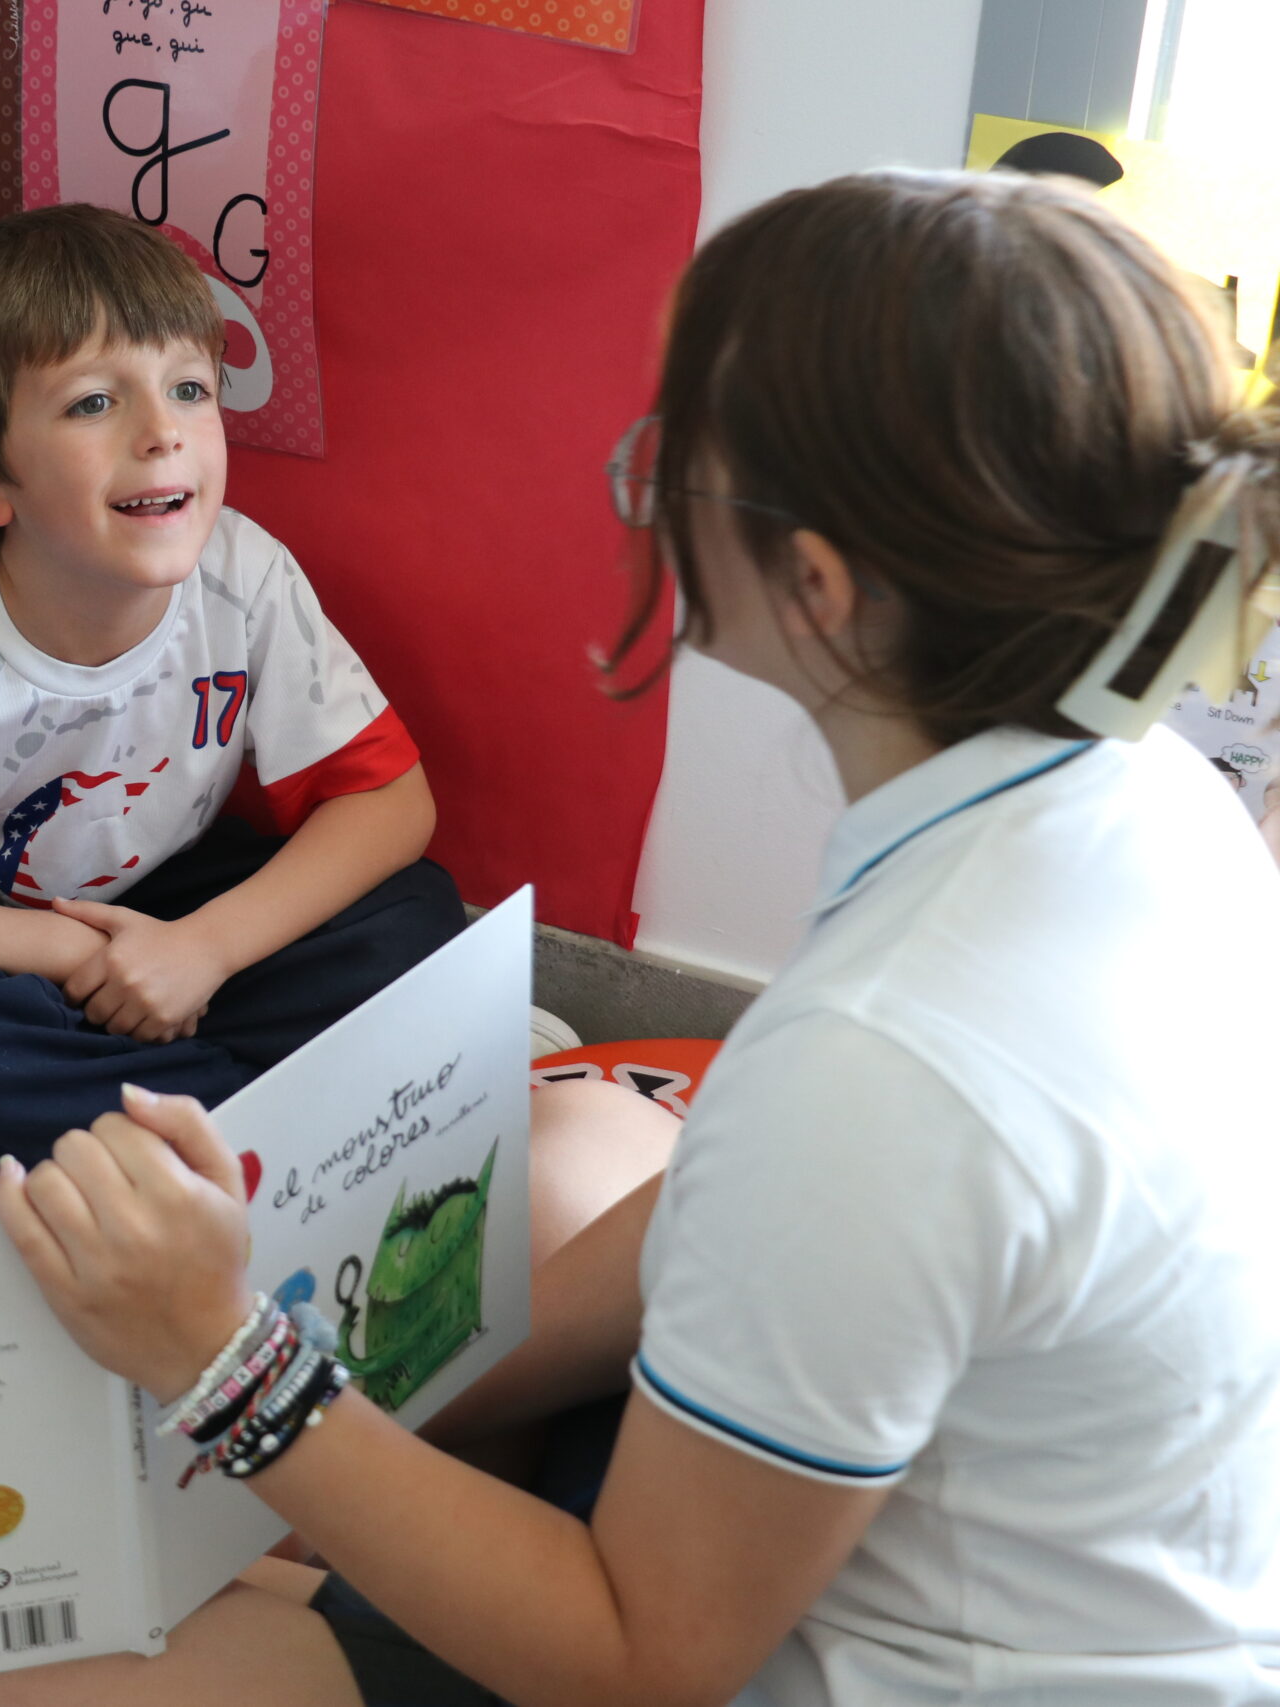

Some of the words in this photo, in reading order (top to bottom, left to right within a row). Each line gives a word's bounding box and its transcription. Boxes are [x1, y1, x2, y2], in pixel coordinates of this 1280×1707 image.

[113, 30, 161, 55] gue,
[170, 38, 205, 62] gui
[103, 78, 230, 226] g
[213, 193, 270, 288] G
[192, 670, 248, 750] 17
[1208, 706, 1222, 720] Sit
[1224, 709, 1254, 725] Down
[1230, 751, 1265, 766] HAPPY
[273, 1167, 303, 1209] el
[312, 1052, 462, 1184] monstruo
[301, 1193, 327, 1224] de
[342, 1115, 430, 1191] colores
